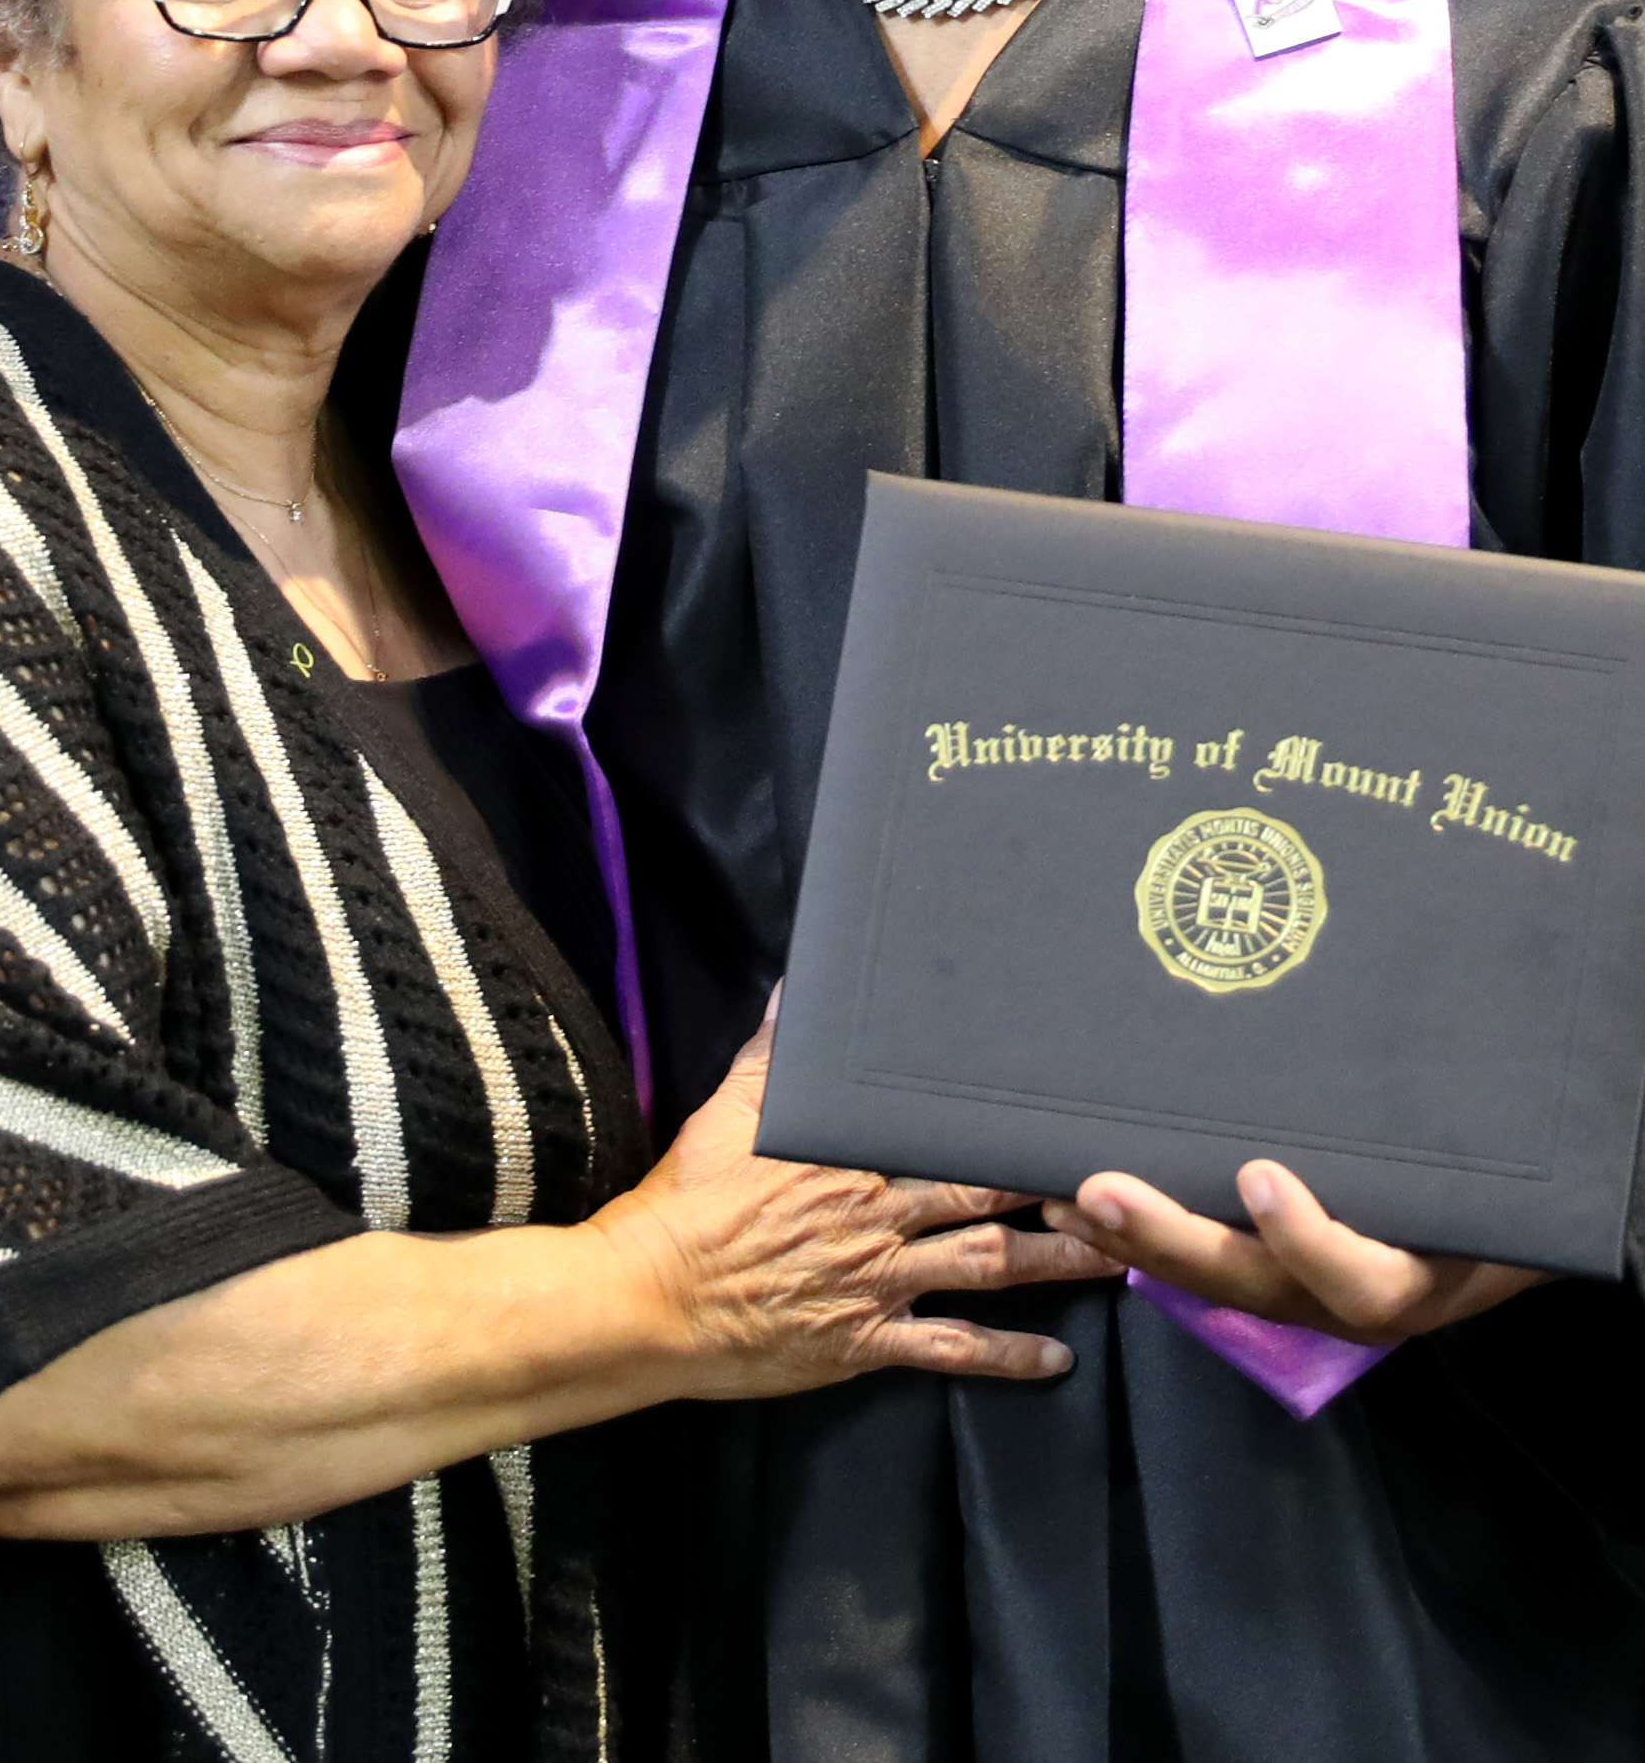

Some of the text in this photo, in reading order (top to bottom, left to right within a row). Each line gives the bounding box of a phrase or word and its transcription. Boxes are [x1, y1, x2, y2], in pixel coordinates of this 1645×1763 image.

[925, 721, 1579, 863] University of Mount Union
